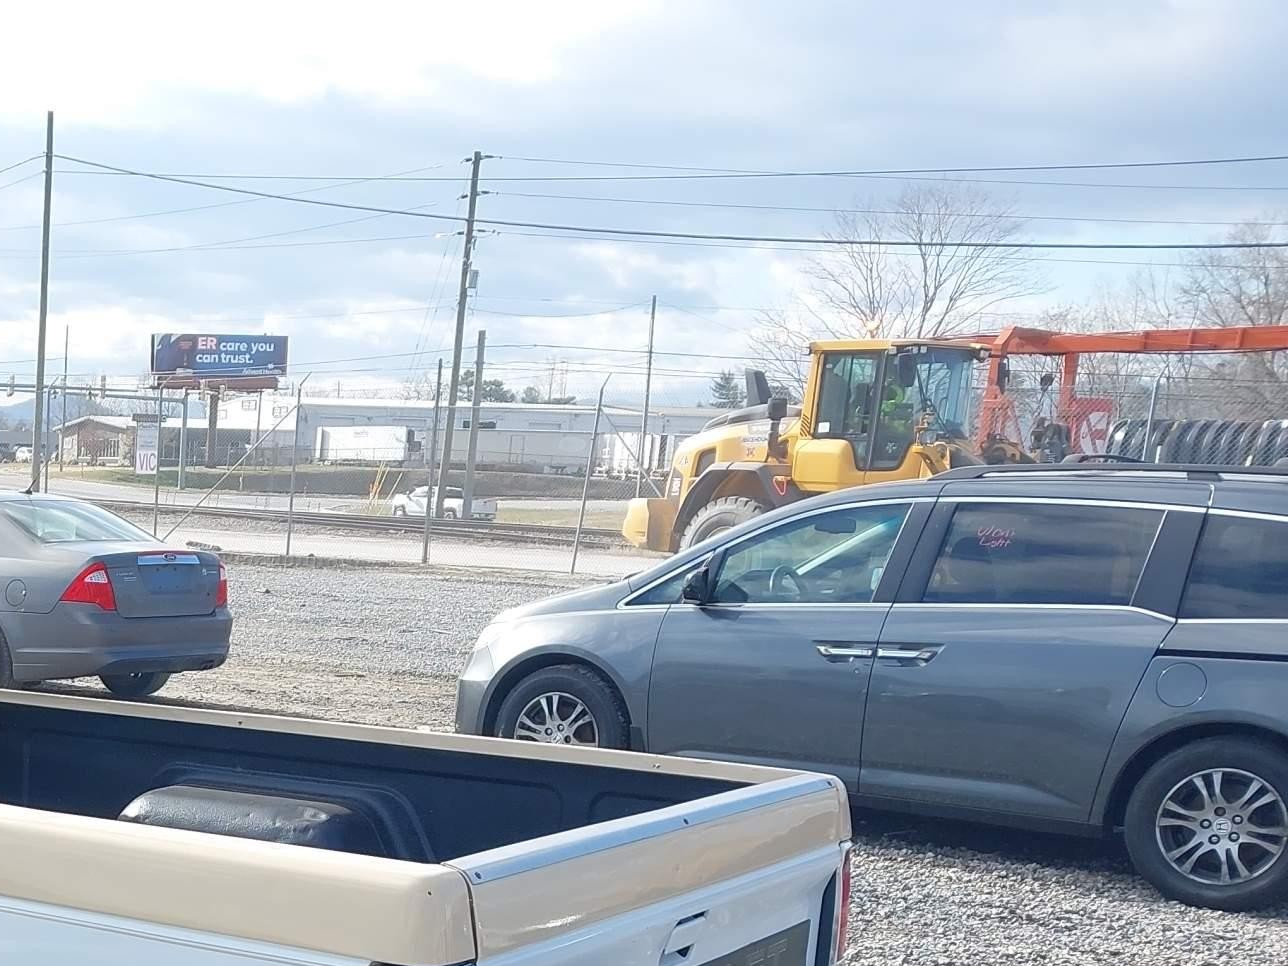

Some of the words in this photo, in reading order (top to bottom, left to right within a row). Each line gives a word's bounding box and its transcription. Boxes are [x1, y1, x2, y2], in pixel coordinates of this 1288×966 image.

[197, 337, 217, 350] ER
[219, 341, 248, 351] care
[251, 342, 275, 353] you
[196, 353, 219, 363] can
[221, 351, 254, 364] trust.
